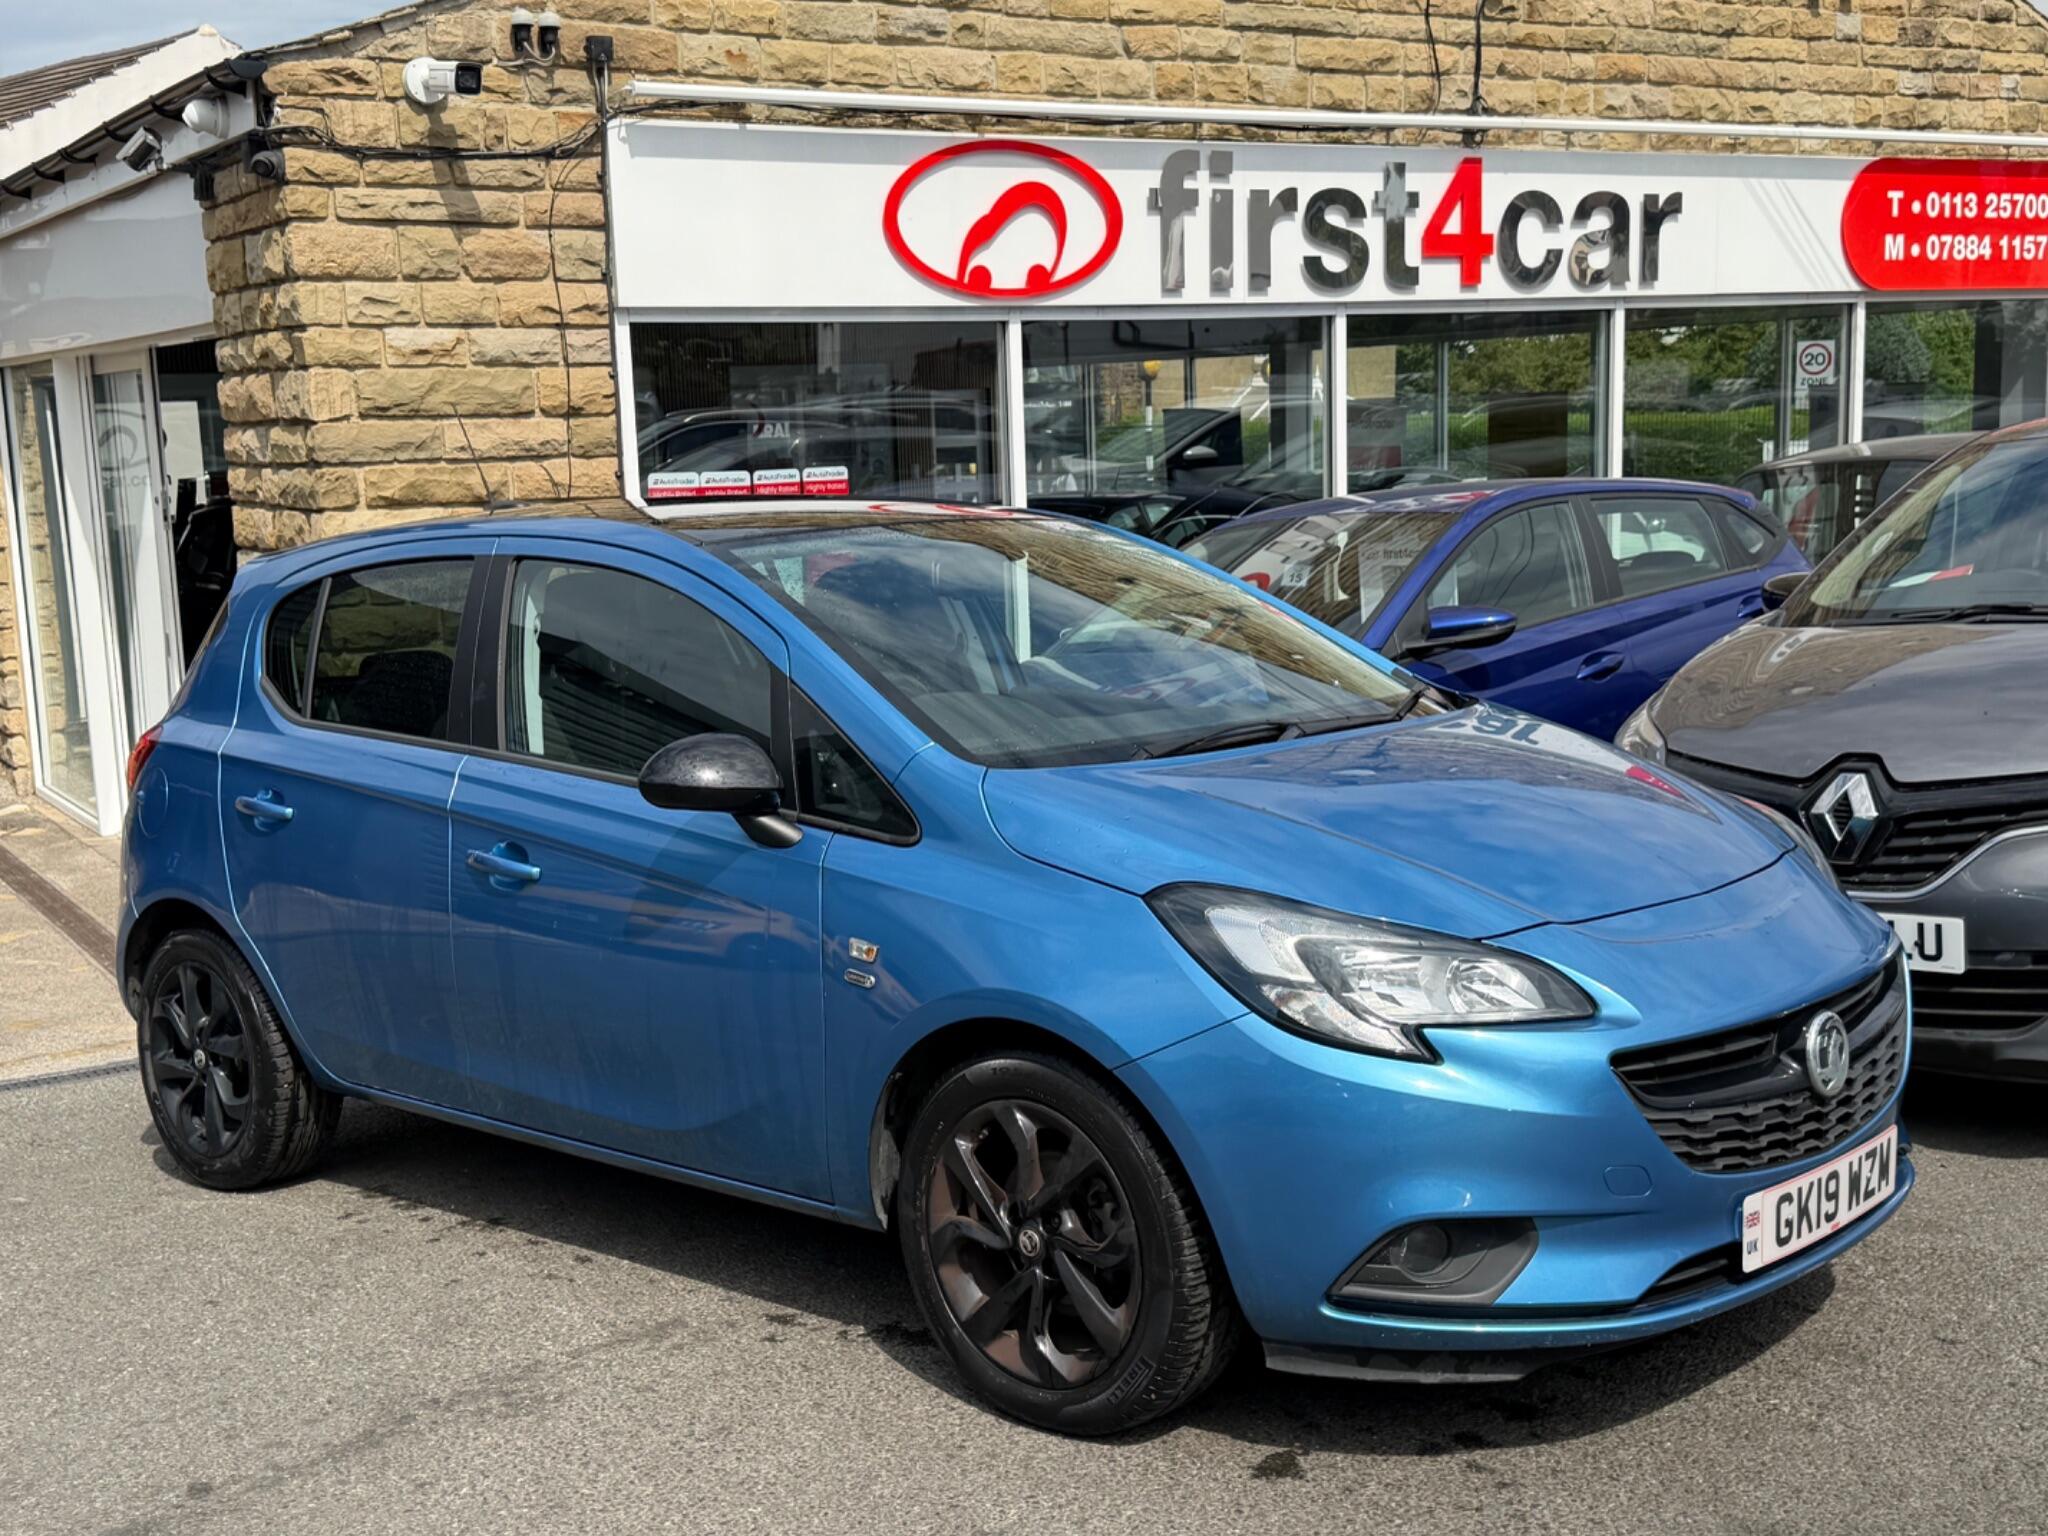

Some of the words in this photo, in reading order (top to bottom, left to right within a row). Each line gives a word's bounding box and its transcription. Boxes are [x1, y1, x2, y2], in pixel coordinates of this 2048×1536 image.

[1887, 189, 1904, 218] T
[1926, 191, 1978, 219] 0113
[1984, 192, 2048, 219] 25700
[1149, 150, 1682, 289] first4car
[1884, 233, 1905, 261] M
[1926, 234, 1992, 261] 07884
[1999, 235, 2048, 261] 1157
[1804, 352, 1826, 366] 20
[1775, 1169, 1840, 1248] GK19
[1746, 1238, 1759, 1256] UK
